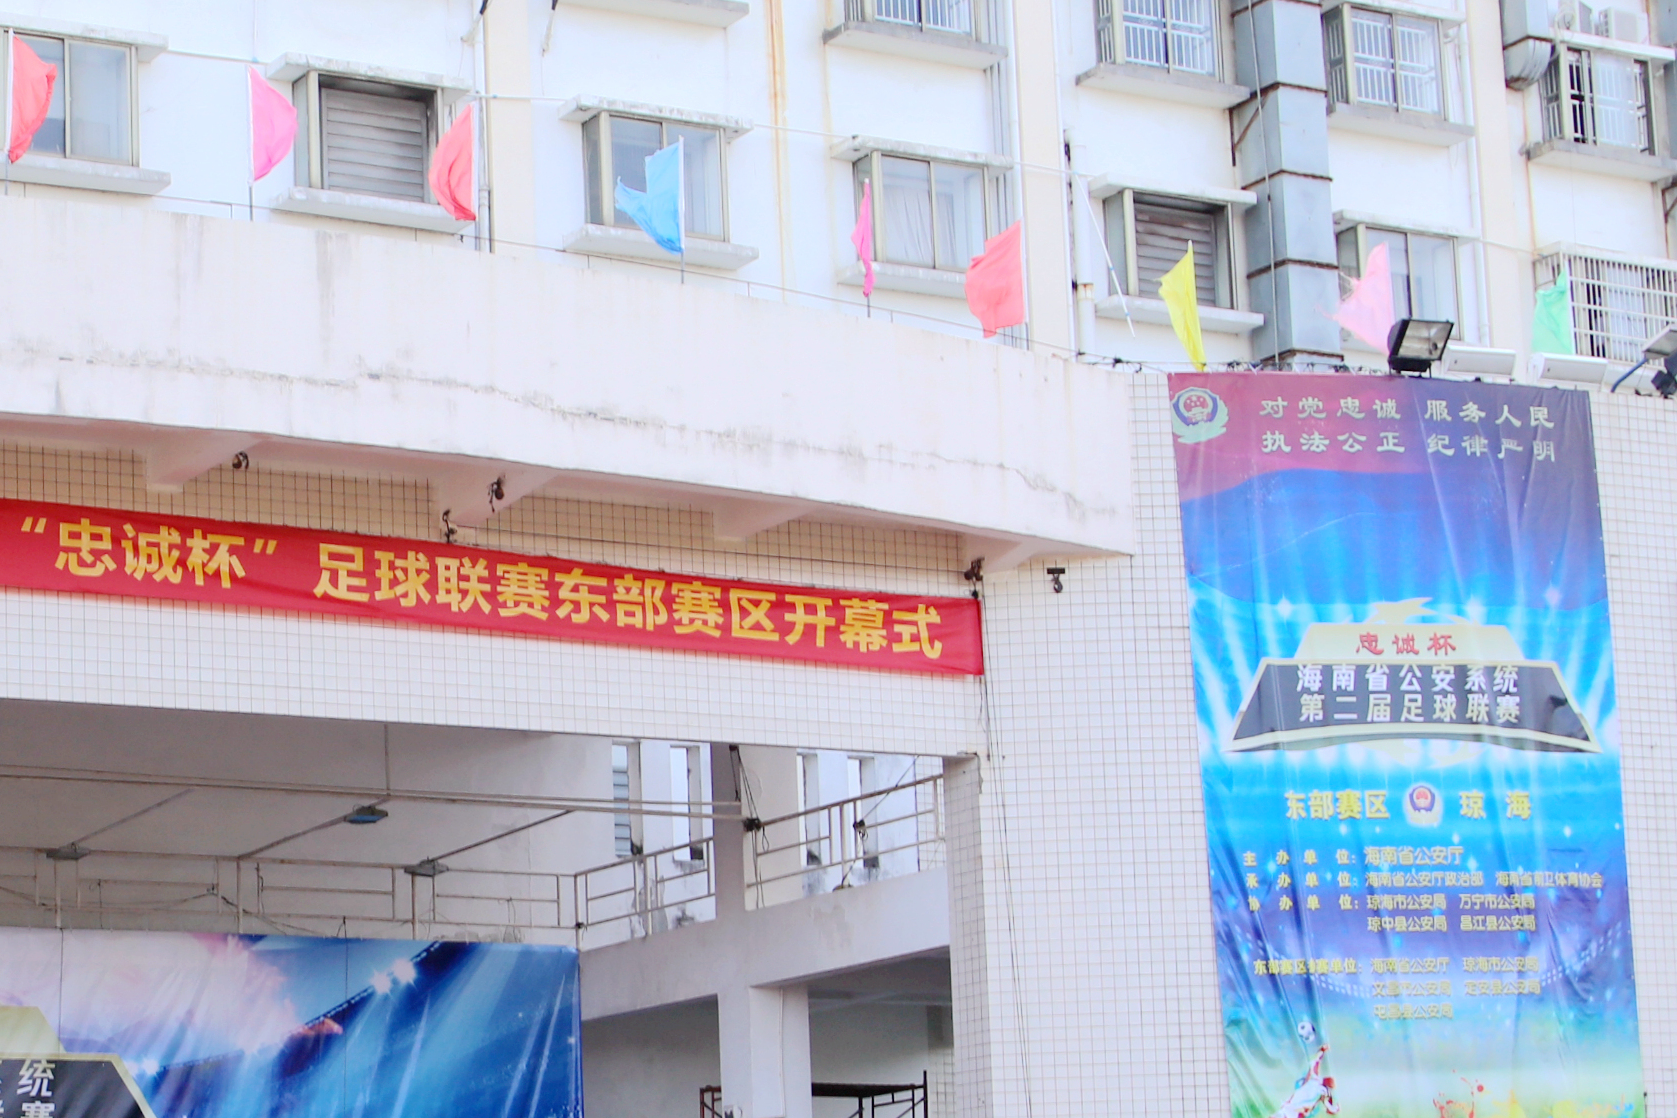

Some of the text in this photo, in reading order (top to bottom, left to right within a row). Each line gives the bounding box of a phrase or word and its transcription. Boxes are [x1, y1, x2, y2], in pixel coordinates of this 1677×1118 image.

[1258, 395, 1555, 430] 对党忠诚 服务人民
[1260, 430, 1556, 463] 执法公正 纪律严明
[1355, 631, 1457, 656] 忠诚杯
[1295, 662, 1519, 694] 海南省公安系统
[1298, 692, 1521, 724] 第二届足球联赛
[1284, 789, 1532, 821] 东部赛区 琼海
[1363, 845, 1465, 867] 海南省公安厅
[1366, 892, 1448, 911] 琼海市公安局
[1458, 892, 1536, 910] 万宁市公安局
[1366, 914, 1536, 933] 琼中县公安局 昌江县公安局
[1370, 957, 1451, 975] 海南省公安厅
[1461, 956, 1540, 973] 琼海市公安局
